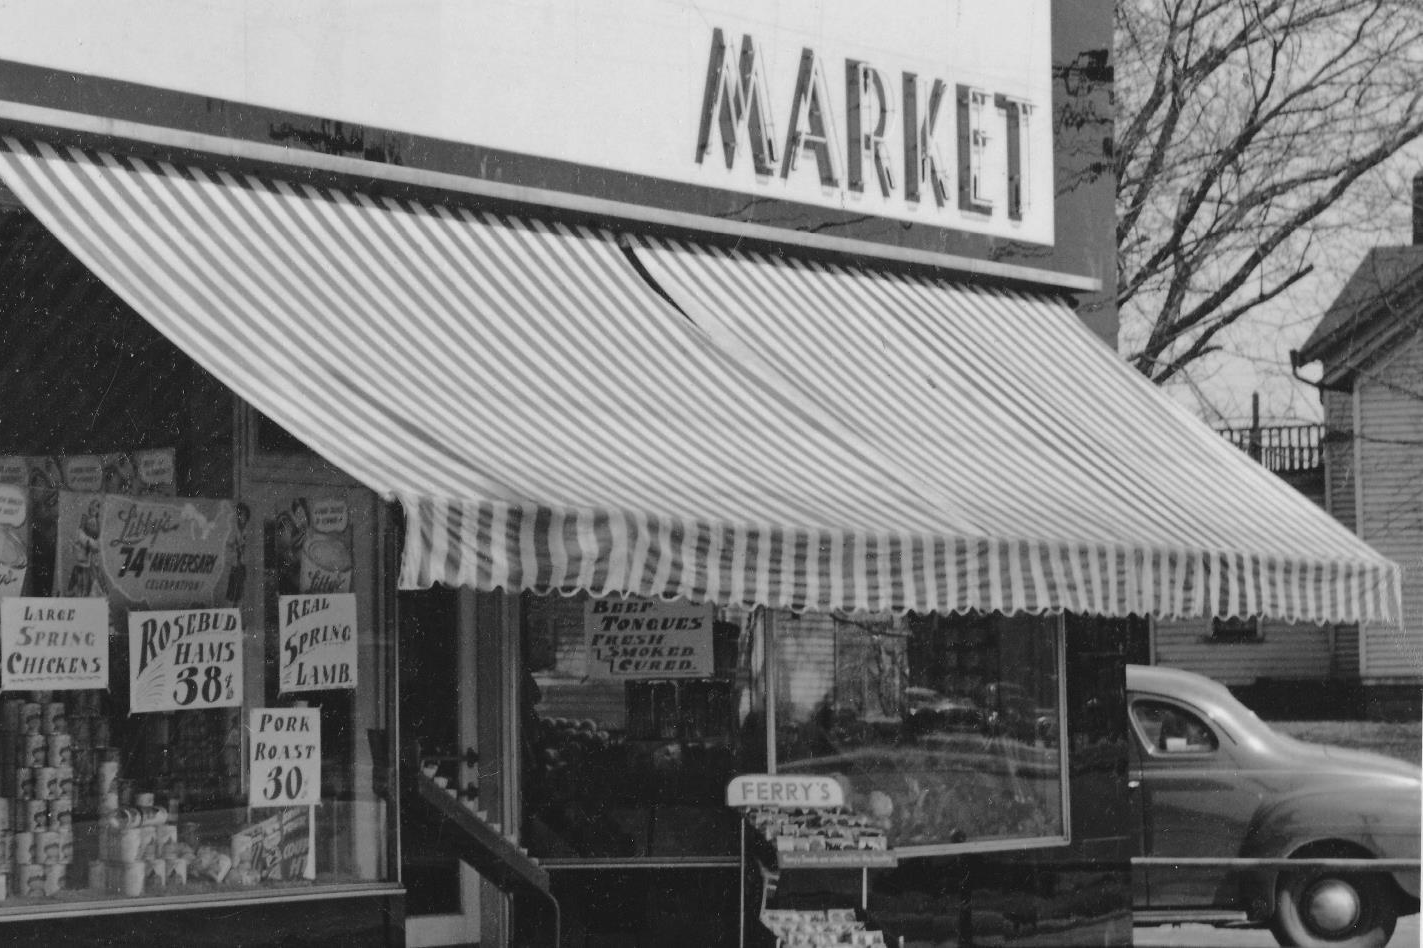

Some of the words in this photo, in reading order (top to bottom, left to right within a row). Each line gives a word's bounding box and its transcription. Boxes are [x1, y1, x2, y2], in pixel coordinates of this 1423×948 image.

[694, 27, 1039, 222] MARKET
[110, 503, 180, 547] Libby's
[149, 552, 218, 574] ANNIVERSARY
[23, 606, 76, 621] LARGE
[286, 598, 330, 626] REAL
[592, 600, 654, 613] BEEF
[601, 616, 704, 631] TONGUES
[16, 626, 95, 647] SPRING
[136, 611, 238, 680] ROSEBUD
[283, 624, 351, 669] SPRING
[591, 634, 666, 646] FRESH
[6, 652, 102, 675] CHICKENS
[173, 642, 235, 665] HAMS
[259, 714, 310, 733] PORK
[254, 742, 316, 761] ROAST
[742, 781, 831, 800] FERRY'S
